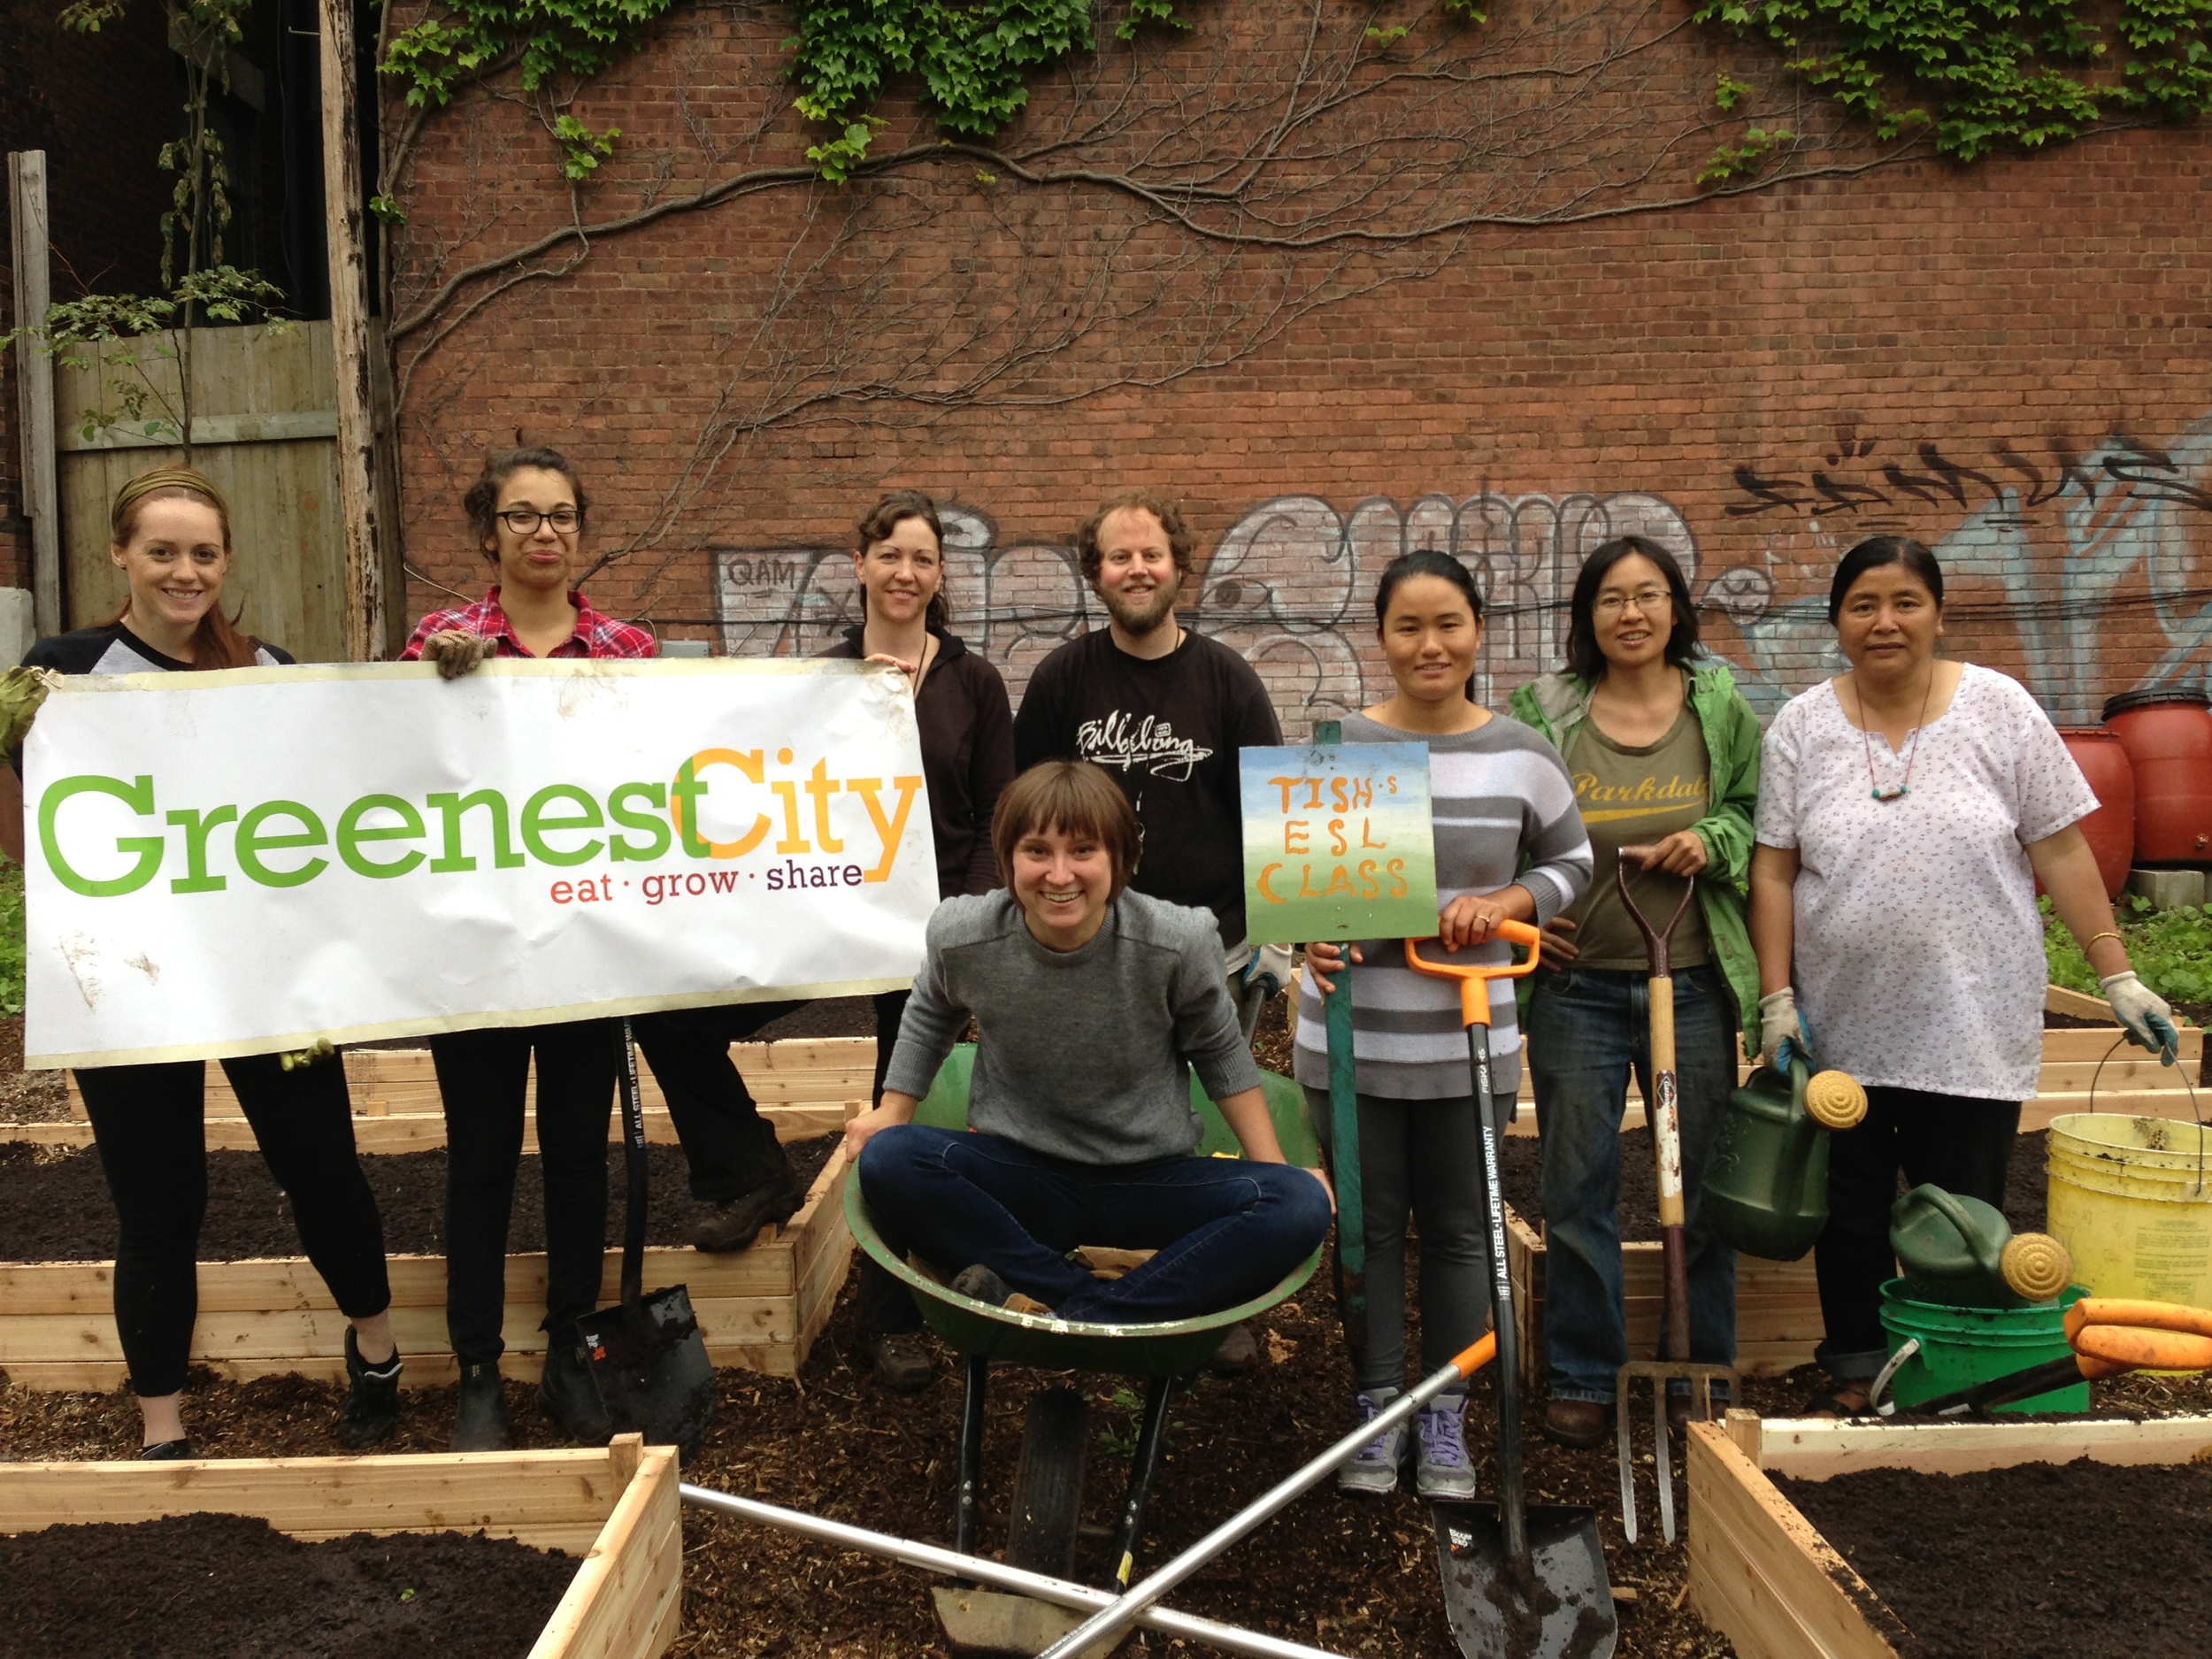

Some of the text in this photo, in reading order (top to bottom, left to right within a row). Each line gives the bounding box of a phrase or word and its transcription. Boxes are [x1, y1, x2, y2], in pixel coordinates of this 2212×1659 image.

[727, 559, 795, 589] QAM
[550, 859, 863, 905] eat grow share
[1256, 857, 1408, 904] CLASS
[626, 1041, 637, 1080] LIFETIME
[631, 1086, 641, 1111] STEEL
[634, 1112, 643, 1129] ALL
[1483, 1125, 1497, 1179] WARRANTY
[1488, 1179, 1502, 1222] LIFETIME
[1493, 1226, 1505, 1257] STEEL
[1496, 1259, 1508, 1279] ALL
